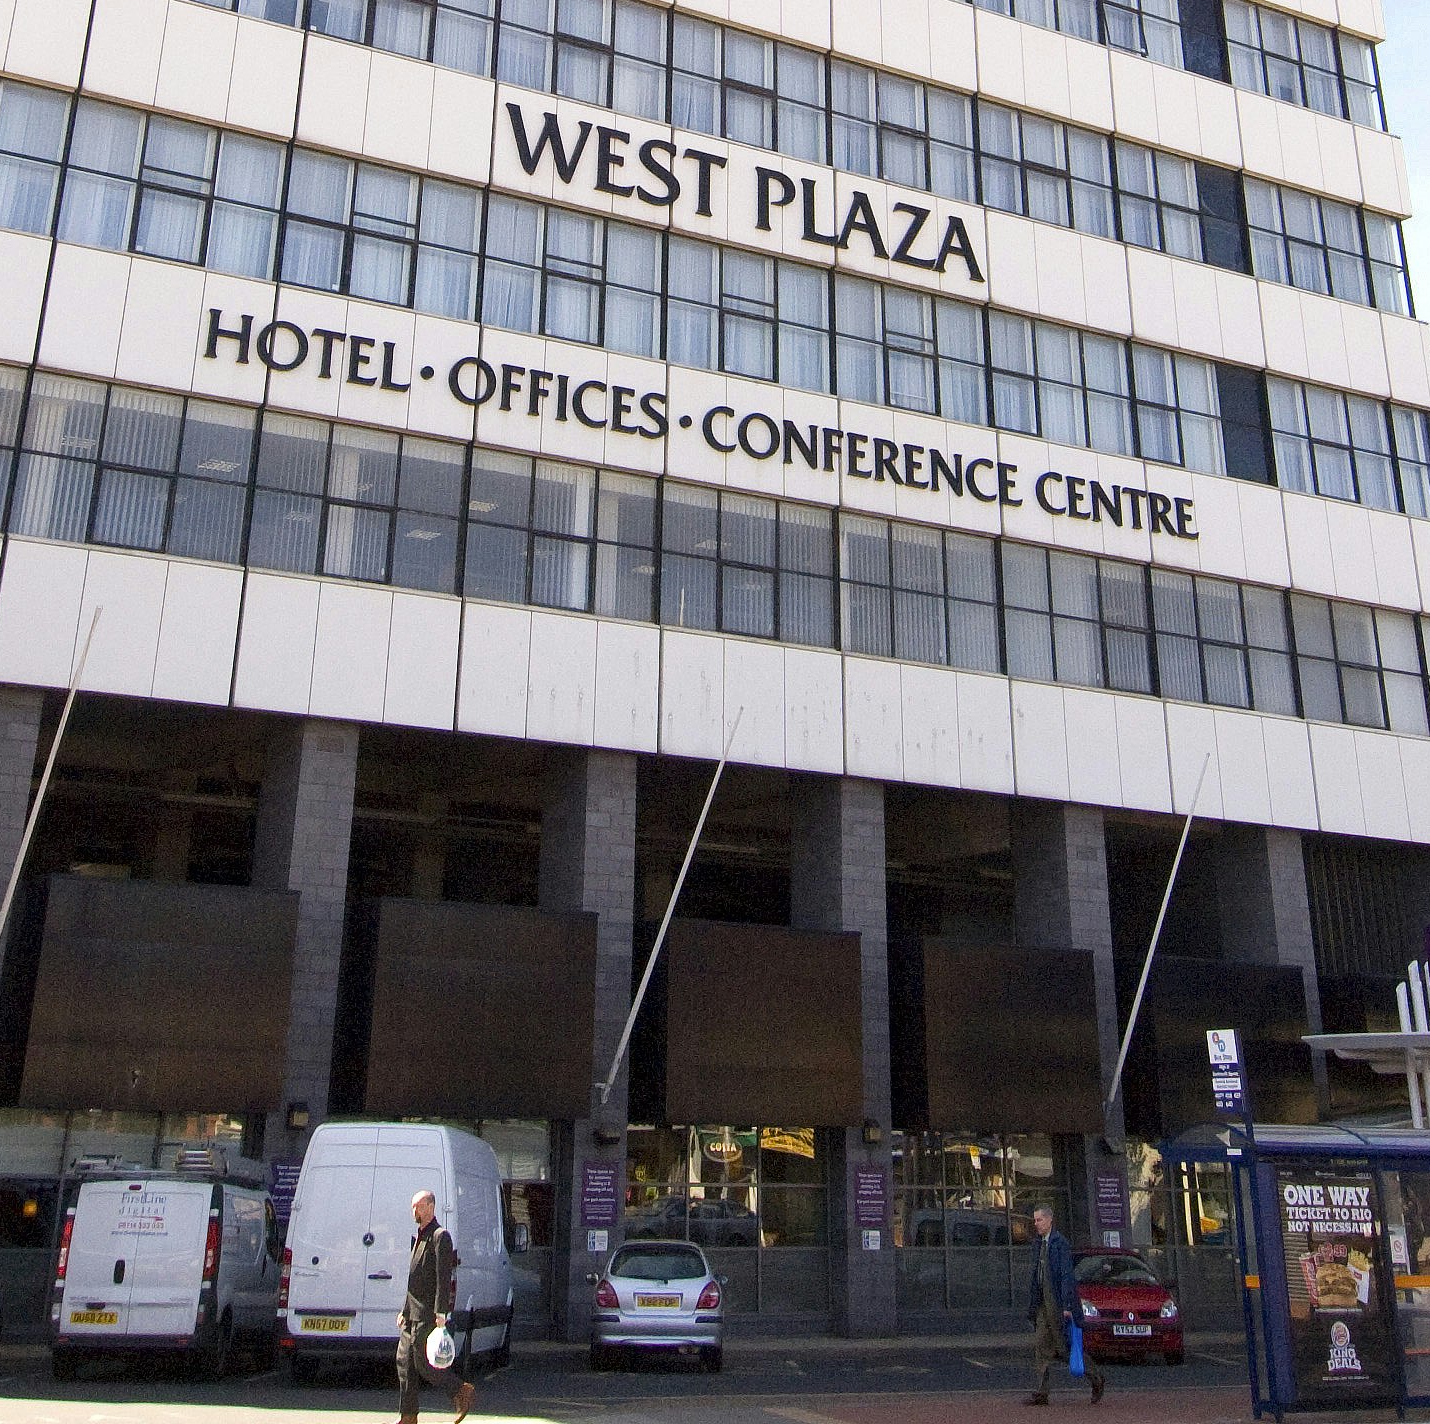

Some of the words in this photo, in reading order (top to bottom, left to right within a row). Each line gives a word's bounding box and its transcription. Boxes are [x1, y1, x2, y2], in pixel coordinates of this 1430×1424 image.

[505, 102, 728, 217] WEST
[754, 165, 986, 283] PLAZA
[204, 308, 410, 393] HOTEL
[448, 356, 670, 440] OFFICES
[701, 405, 1023, 508] CONFERENCE
[1035, 471, 1200, 541] CENTRE
[709, 1142, 737, 1153] COSTA
[1283, 1184, 1325, 1206] ONE
[1327, 1186, 1370, 1206] WAY
[1286, 1206, 1331, 1220] TICKET
[1333, 1207, 1349, 1220] TO
[1350, 1208, 1372, 1221] RIO
[1287, 1220, 1310, 1233] NOT
[1329, 1348, 1356, 1359] KING
[1327, 1358, 1362, 1372] DEALS
